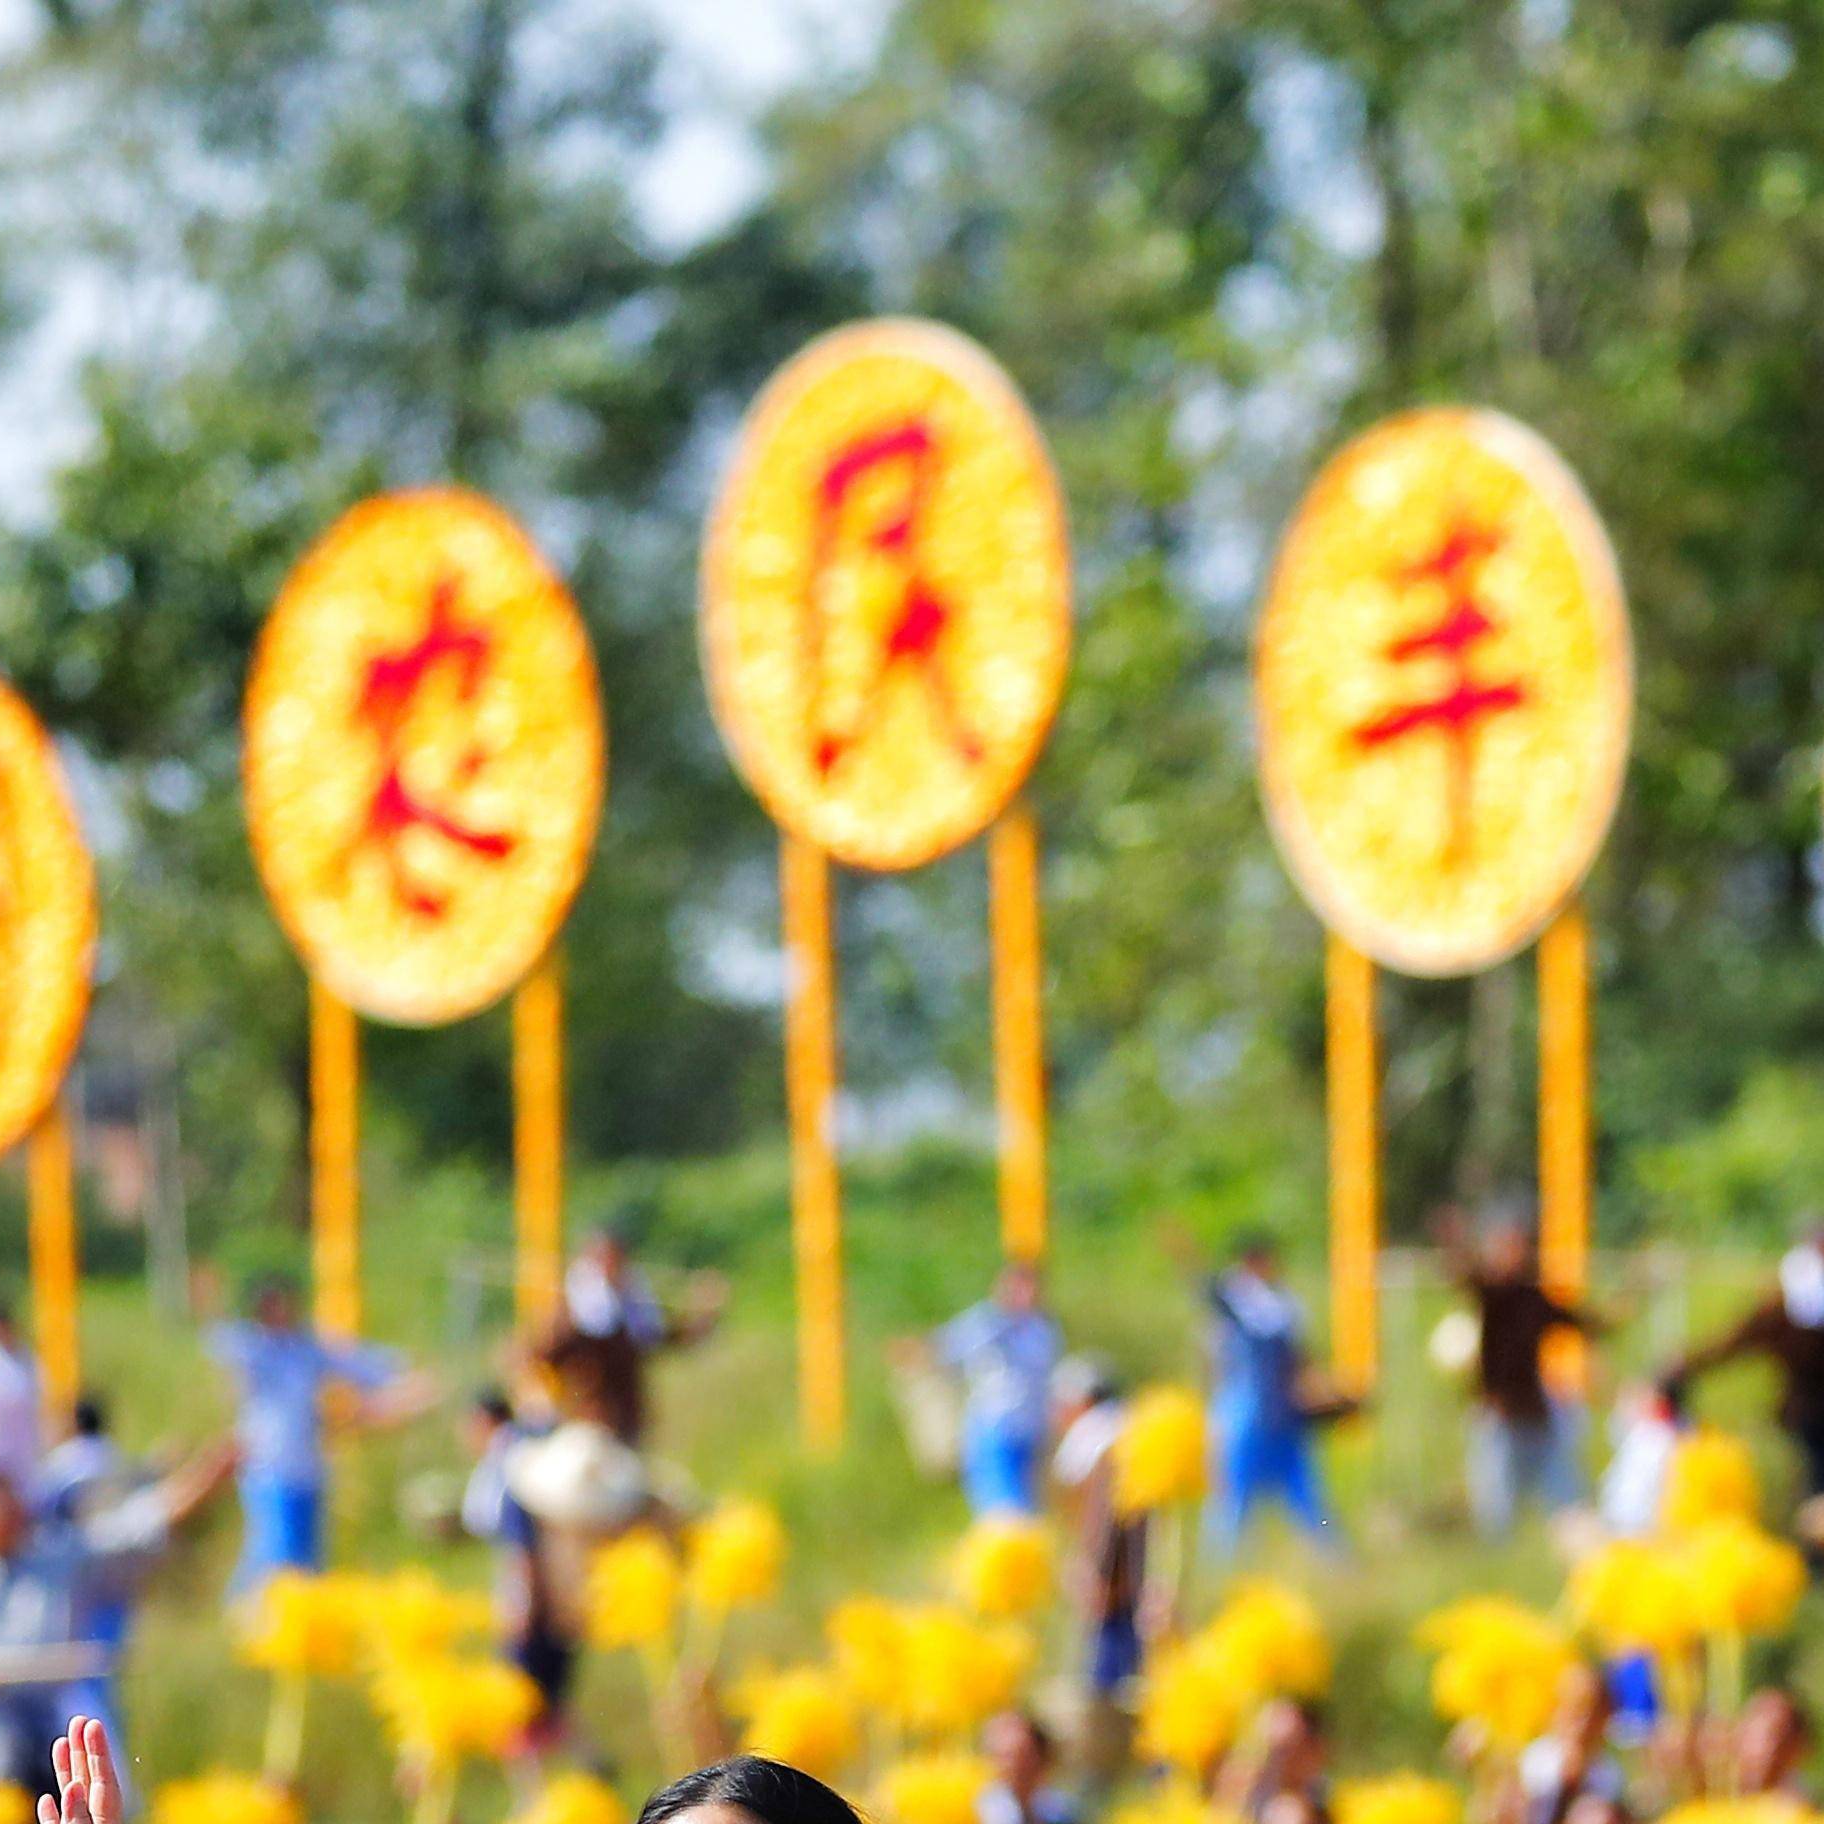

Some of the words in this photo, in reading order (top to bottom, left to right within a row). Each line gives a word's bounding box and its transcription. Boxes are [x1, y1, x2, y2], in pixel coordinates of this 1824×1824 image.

[355, 580, 516, 920] 农
[812, 418, 982, 778] 民
[1352, 520, 1526, 866] 丰
